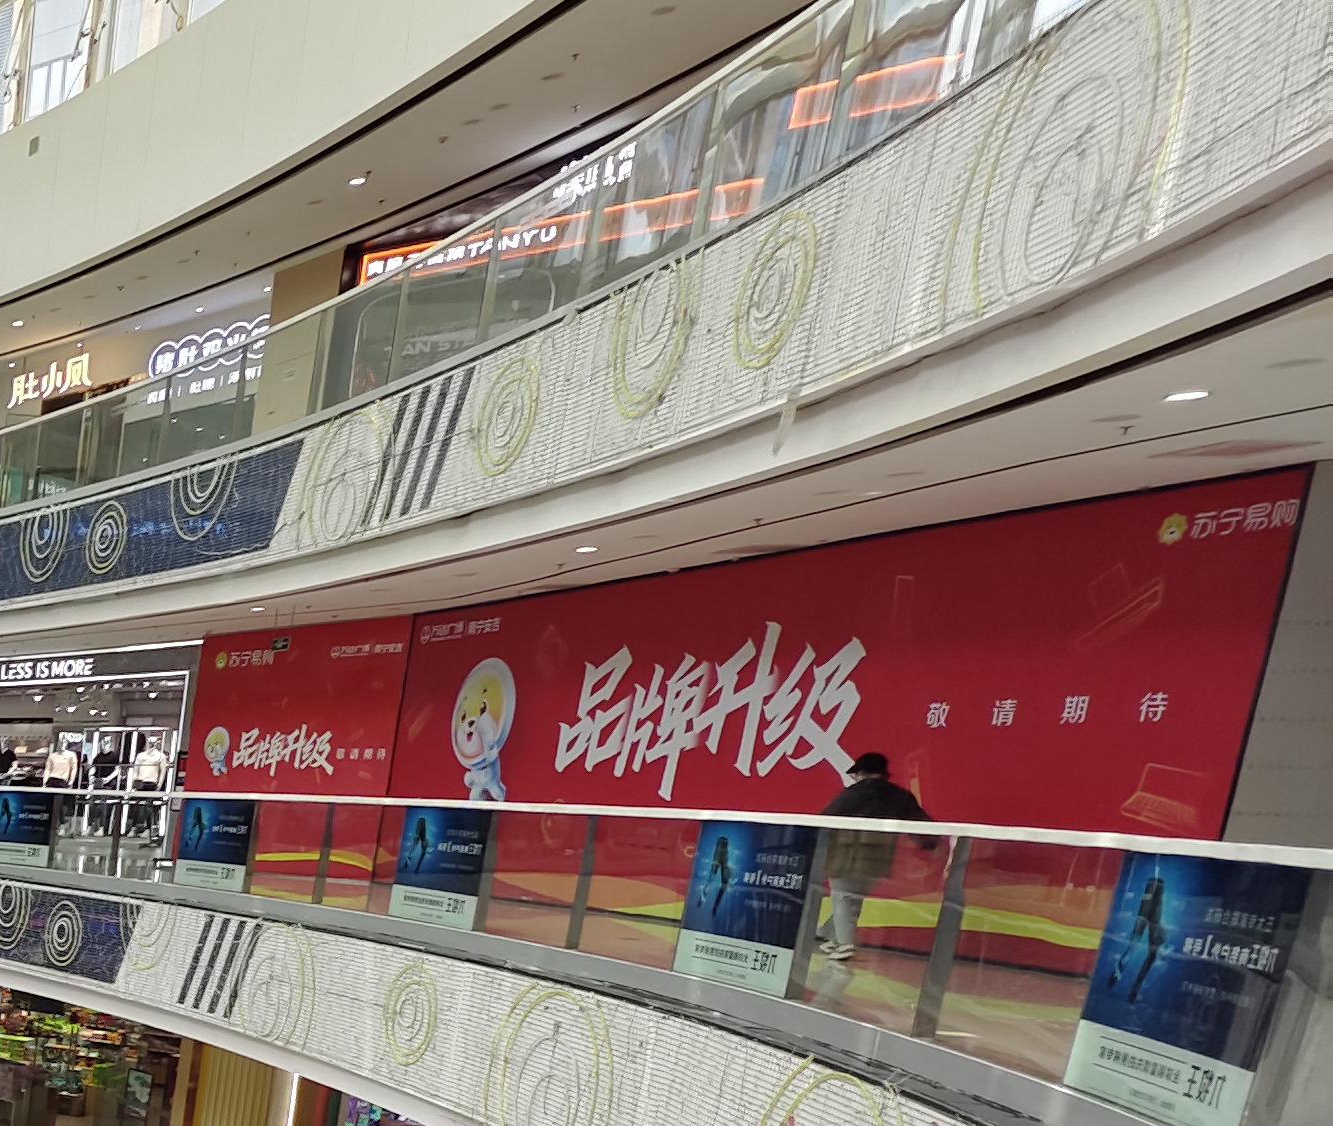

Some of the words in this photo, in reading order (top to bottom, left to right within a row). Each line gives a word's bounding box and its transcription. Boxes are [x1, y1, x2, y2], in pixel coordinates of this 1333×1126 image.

[7, 354, 92, 409] 肚小凤
[1189, 500, 1301, 539] 苏宁易购
[0, 662, 33, 681] LESS
[35, 661, 49, 679] IS
[51, 658, 95, 677] MORE
[228, 649, 275, 668] 苏宁易购
[554, 620, 867, 801] 品牌升级
[232, 723, 334, 777] 品牌升级
